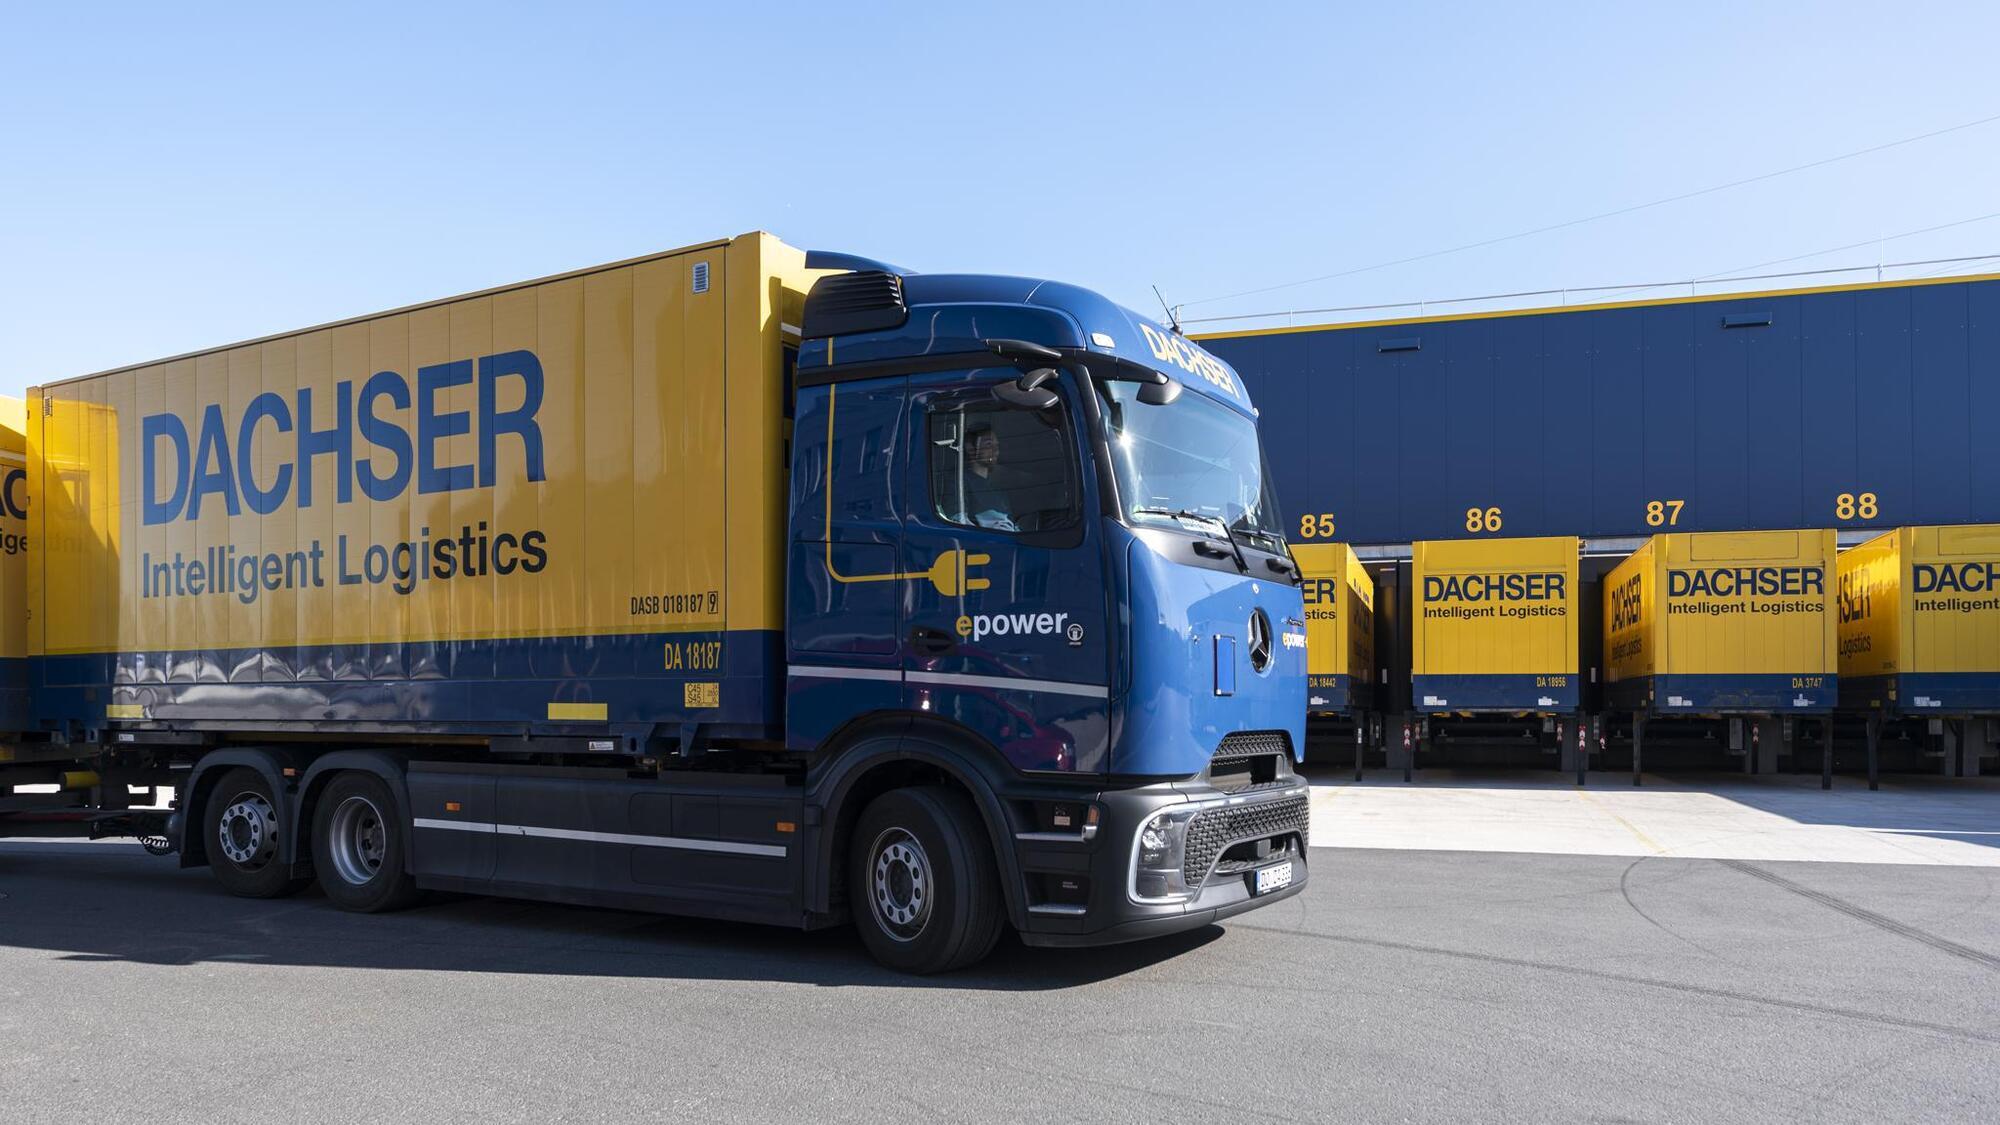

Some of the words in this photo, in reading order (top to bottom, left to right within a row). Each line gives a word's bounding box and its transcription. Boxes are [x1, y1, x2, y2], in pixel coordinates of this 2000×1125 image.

[1140, 323, 1240, 400] DACHSER
[143, 350, 547, 526] DACHSER
[1646, 500, 1685, 526] 87
[1836, 492, 1878, 519] 88
[1300, 514, 1335, 538] 85
[1465, 507, 1502, 532] 86
[143, 540, 324, 604] Intelligent
[338, 521, 548, 596] Logistics
[1424, 574, 1566, 602] DACHSER
[1668, 567, 1824, 597] DACHSER
[631, 596, 660, 615] DASB
[663, 593, 704, 614] 018187
[708, 592, 718, 613] 9
[1424, 606, 1495, 620] Intelligent
[1499, 604, 1567, 619] Logistics
[1668, 602, 1746, 616] Intelligent
[1750, 600, 1825, 615] Logistics
[1915, 598, 2000, 613] Intelligent
[956, 612, 1068, 642] epower
[664, 642, 683, 670] DA
[686, 641, 721, 670] 18187
[1536, 676, 1547, 688] DA
[1792, 677, 1802, 689] DA
[1805, 677, 1823, 689] 3747
